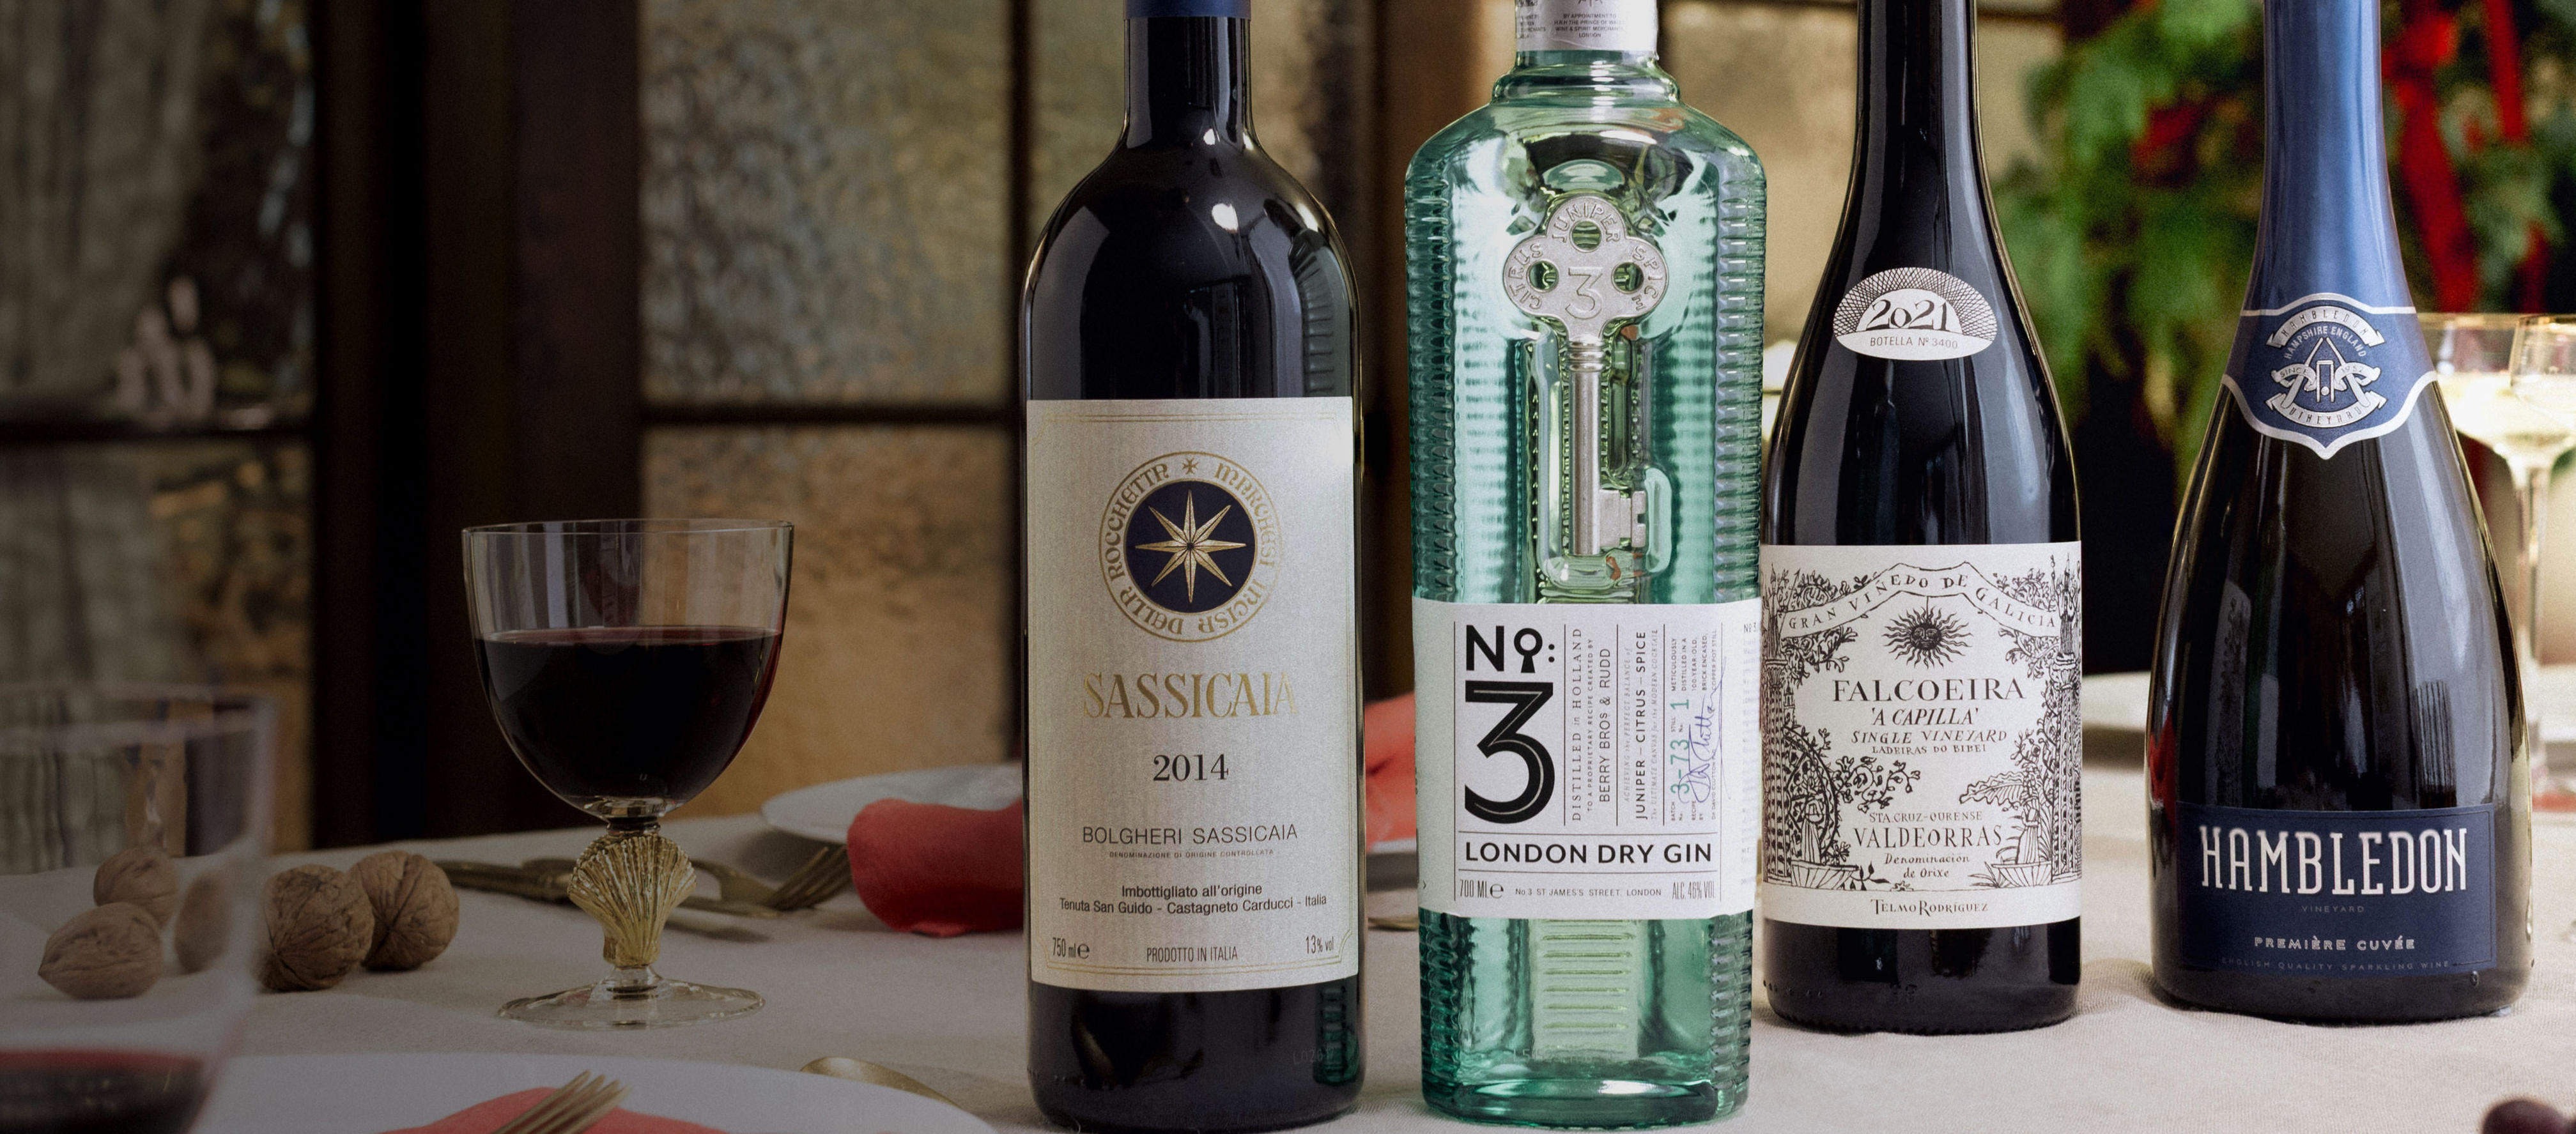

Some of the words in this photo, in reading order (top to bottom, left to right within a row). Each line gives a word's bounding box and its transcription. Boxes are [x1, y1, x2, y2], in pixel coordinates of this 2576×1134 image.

[1553, 203, 1621, 243] JUNIPER
[1508, 243, 1543, 310] CITRUS
[1632, 245, 1663, 311] SPICE
[1566, 266, 1603, 319] 3
[1865, 300, 1947, 331] 2021
[1870, 337, 1913, 346] BOTELLA
[2284, 326, 2328, 359] HAMPSHIRE
[2331, 326, 2366, 356] ENGLAND
[2279, 367, 2308, 378] SINCE
[1104, 463, 1170, 582] ROCCHETTA
[1789, 608, 1837, 629] GRAN
[1943, 574, 1968, 589] DE
[1975, 586, 2056, 628] GALICIA
[1587, 639, 1593, 648] BY
[1636, 632, 1646, 673] SPICE
[1572, 629, 1582, 709] HOLLAND
[1600, 648, 1610, 687] RUDD
[1084, 671, 1299, 719] SASSICAIA
[1600, 696, 1610, 705] &
[1832, 677, 2027, 702] FALCOEIRA
[1636, 690, 1646, 742] CITRUS
[1851, 730, 1912, 744] SINGLE
[1920, 729, 2007, 742] VINEYARD
[1464, 680, 1555, 824] 3
[1872, 746, 1927, 755] LADEIRAS
[1153, 754, 1229, 782] 2014
[1572, 733, 1582, 821] DISTILLED
[1600, 756, 1610, 802] BERRY
[1636, 760, 1647, 820] JUNIPER
[1587, 801, 1593, 811] TO
[1083, 827, 1182, 845] BOLGHERI
[1192, 824, 1298, 845] SASSICAIA
[1853, 824, 2002, 848] VALDEORRAS
[1465, 841, 1588, 864] LONDON
[1598, 844, 1655, 864] DRY
[1663, 843, 1711, 862] GIN
[2199, 824, 2467, 895] HAMBLEDON
[1904, 867, 1915, 878] de
[1920, 868, 1949, 878] Orixe
[1121, 885, 1198, 900] Imbottigliato
[1201, 884, 1263, 898] all'origine
[1460, 878, 1474, 898] 700
[1060, 898, 1090, 912] Tenuta
[1093, 900, 1114, 913] San
[1118, 901, 1153, 914] Guido
[1167, 901, 1238, 916] Castagneto
[1242, 896, 1293, 912] Carducci
[1305, 894, 1327, 907] Italia
[1870, 899, 1917, 915] TELMO
[2301, 905, 2364, 914] VINEYARD
[1053, 937, 1067, 957] 750
[1146, 947, 1194, 963] PRODOTTO
[1197, 947, 1207, 962] IN
[1210, 946, 1238, 960] ITALIA
[1306, 935, 1323, 954] 13%
[1325, 936, 1334, 952] vol
[2254, 935, 2347, 951] PREMIÈRE
[2356, 935, 2416, 951] CUVÉE
[2278, 962, 2334, 970] QUALITY
[2341, 962, 2414, 970] SPARKLING
[2421, 960, 2449, 969] WINE
